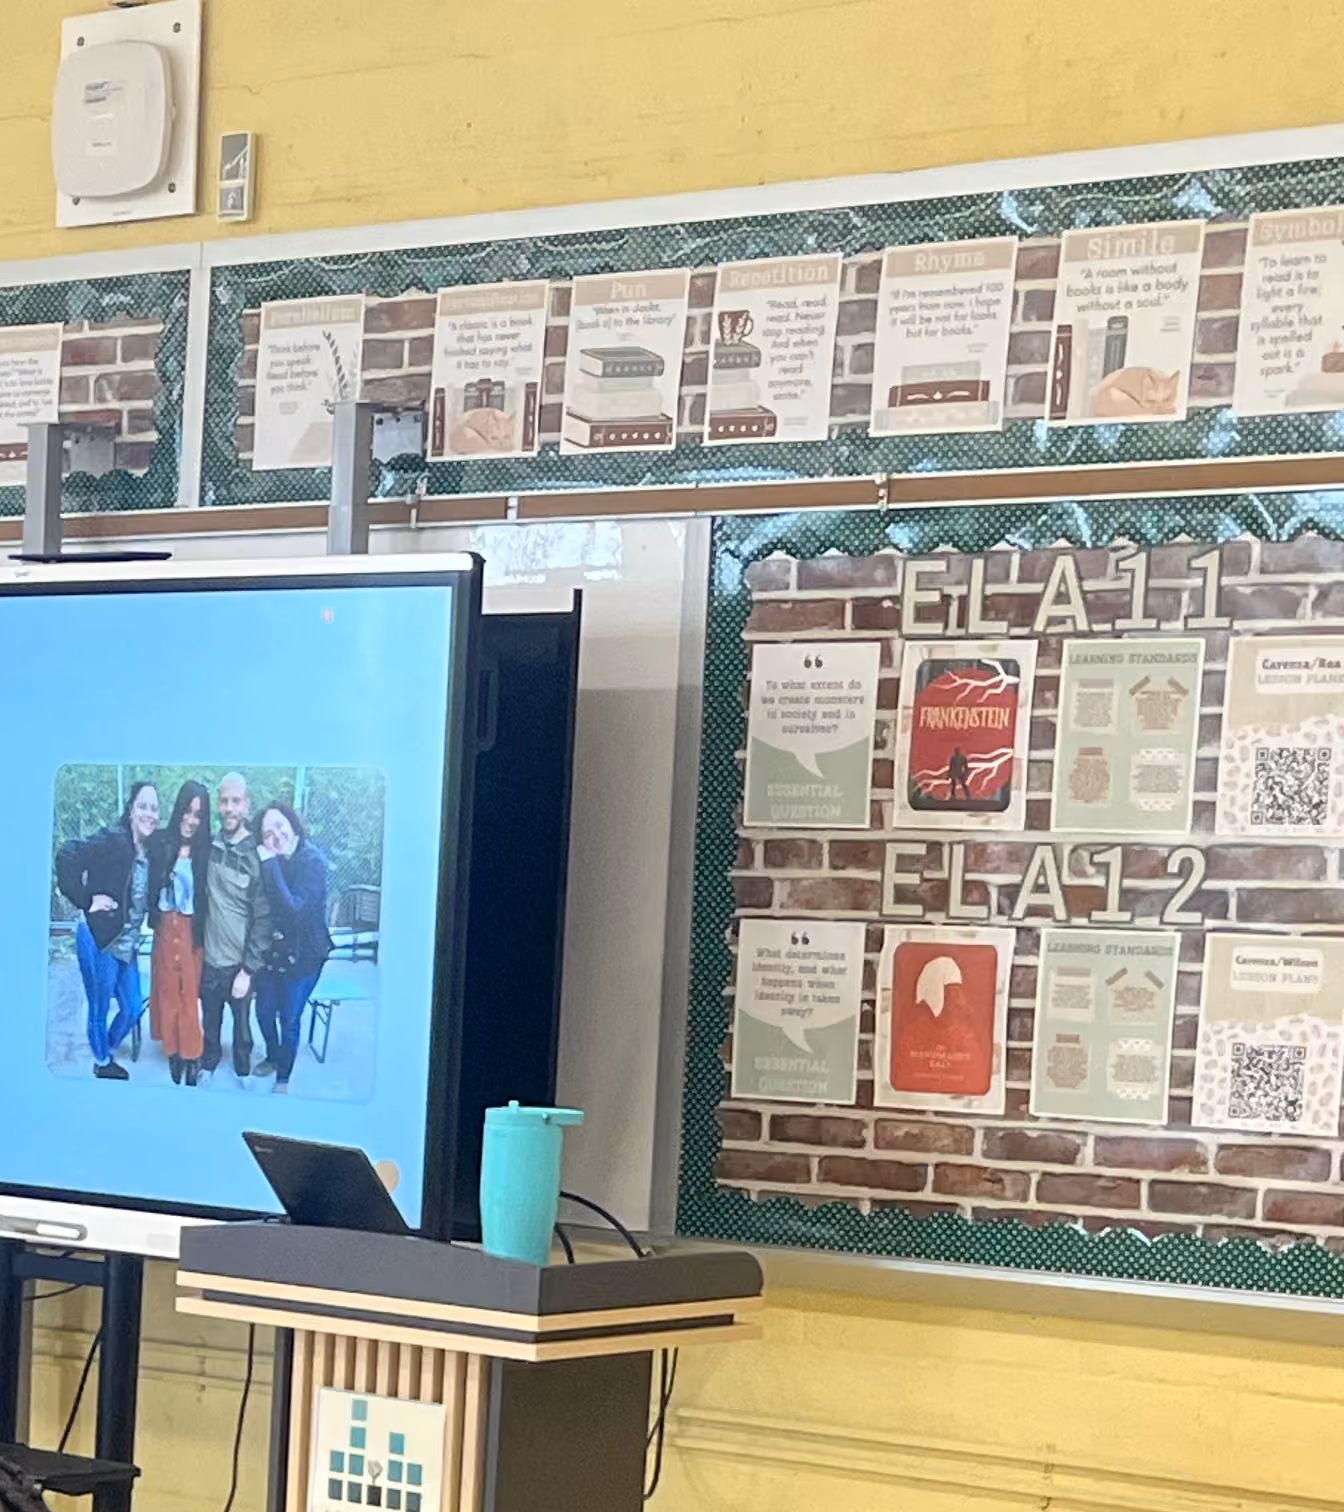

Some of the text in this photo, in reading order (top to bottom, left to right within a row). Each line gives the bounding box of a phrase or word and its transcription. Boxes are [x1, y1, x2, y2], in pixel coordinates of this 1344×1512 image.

[1087, 230, 1175, 259] Simile
[914, 251, 985, 272] Rhyme
[1280, 253, 1328, 266] learn to
[727, 263, 829, 289] Repetition
[1096, 262, 1177, 279] room without
[1262, 270, 1320, 283] read is to
[611, 280, 647, 300] Pun
[1067, 278, 1189, 297] books is like a body
[1257, 287, 1294, 303] light a
[1077, 299, 1121, 313] without
[1124, 300, 1133, 310] a
[1271, 301, 1305, 314] every
[1298, 315, 1323, 326] that
[919, 706, 1011, 731] FRANKENSTEIN
[768, 783, 843, 799] ESSENTIAL
[770, 804, 842, 821] QUESTION
